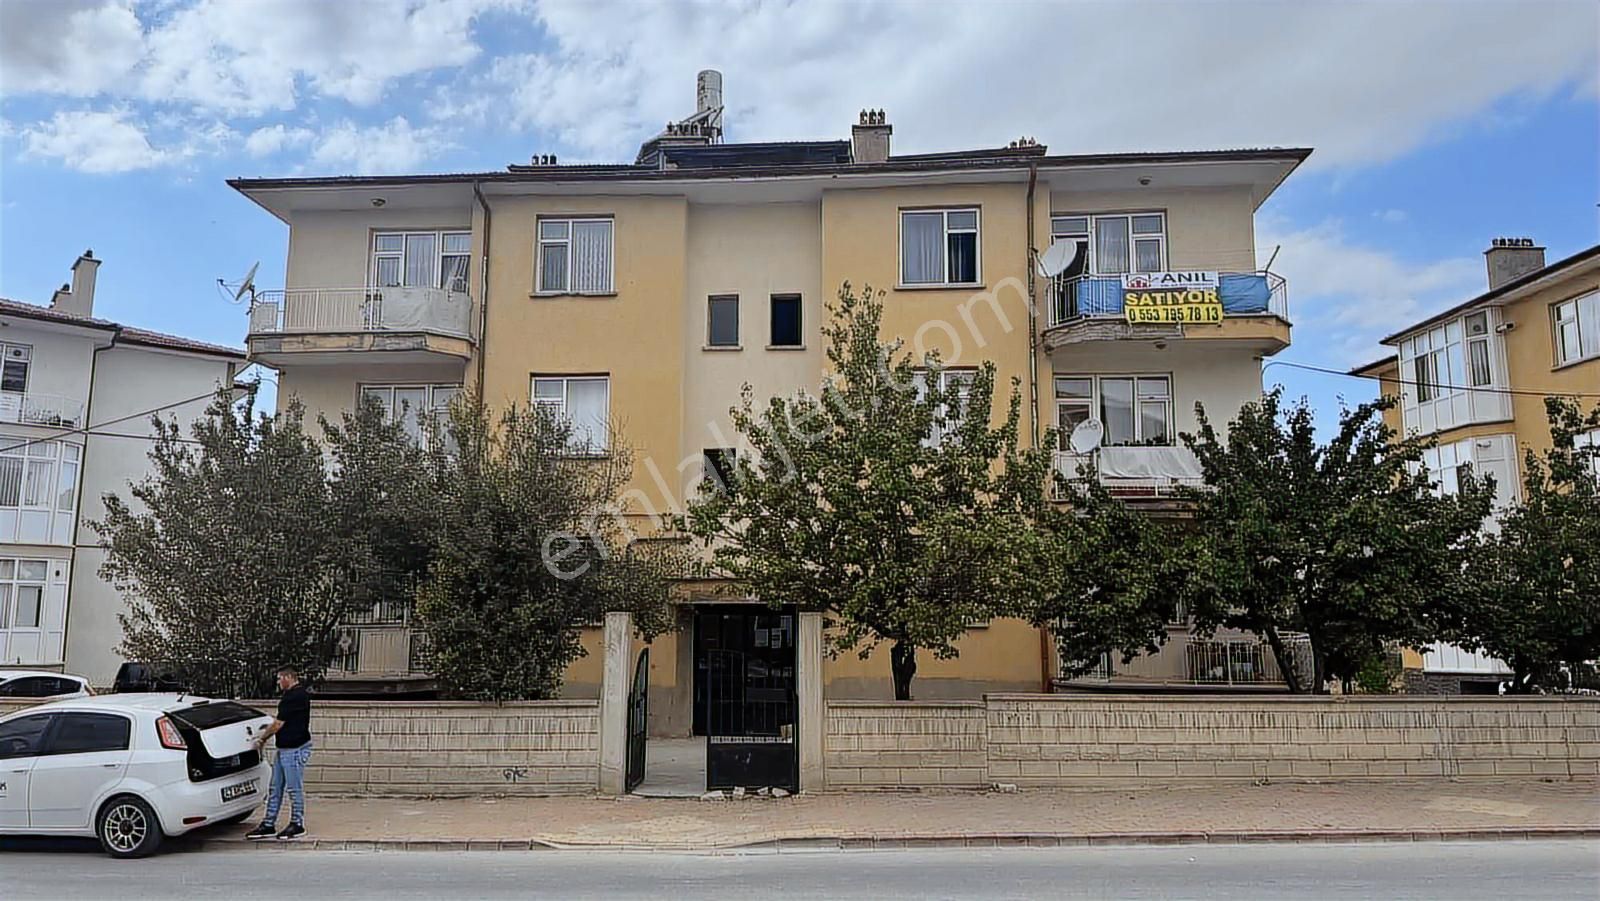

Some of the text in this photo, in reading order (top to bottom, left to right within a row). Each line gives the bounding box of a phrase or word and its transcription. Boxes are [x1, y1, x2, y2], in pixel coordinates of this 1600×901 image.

[1161, 272, 1214, 284] ANIL
[1126, 290, 1218, 305] SATIYOR
[1129, 309, 1136, 321] 0
[1139, 308, 1160, 321] 553
[1187, 307, 1201, 320] 78
[1206, 306, 1219, 320] 13
